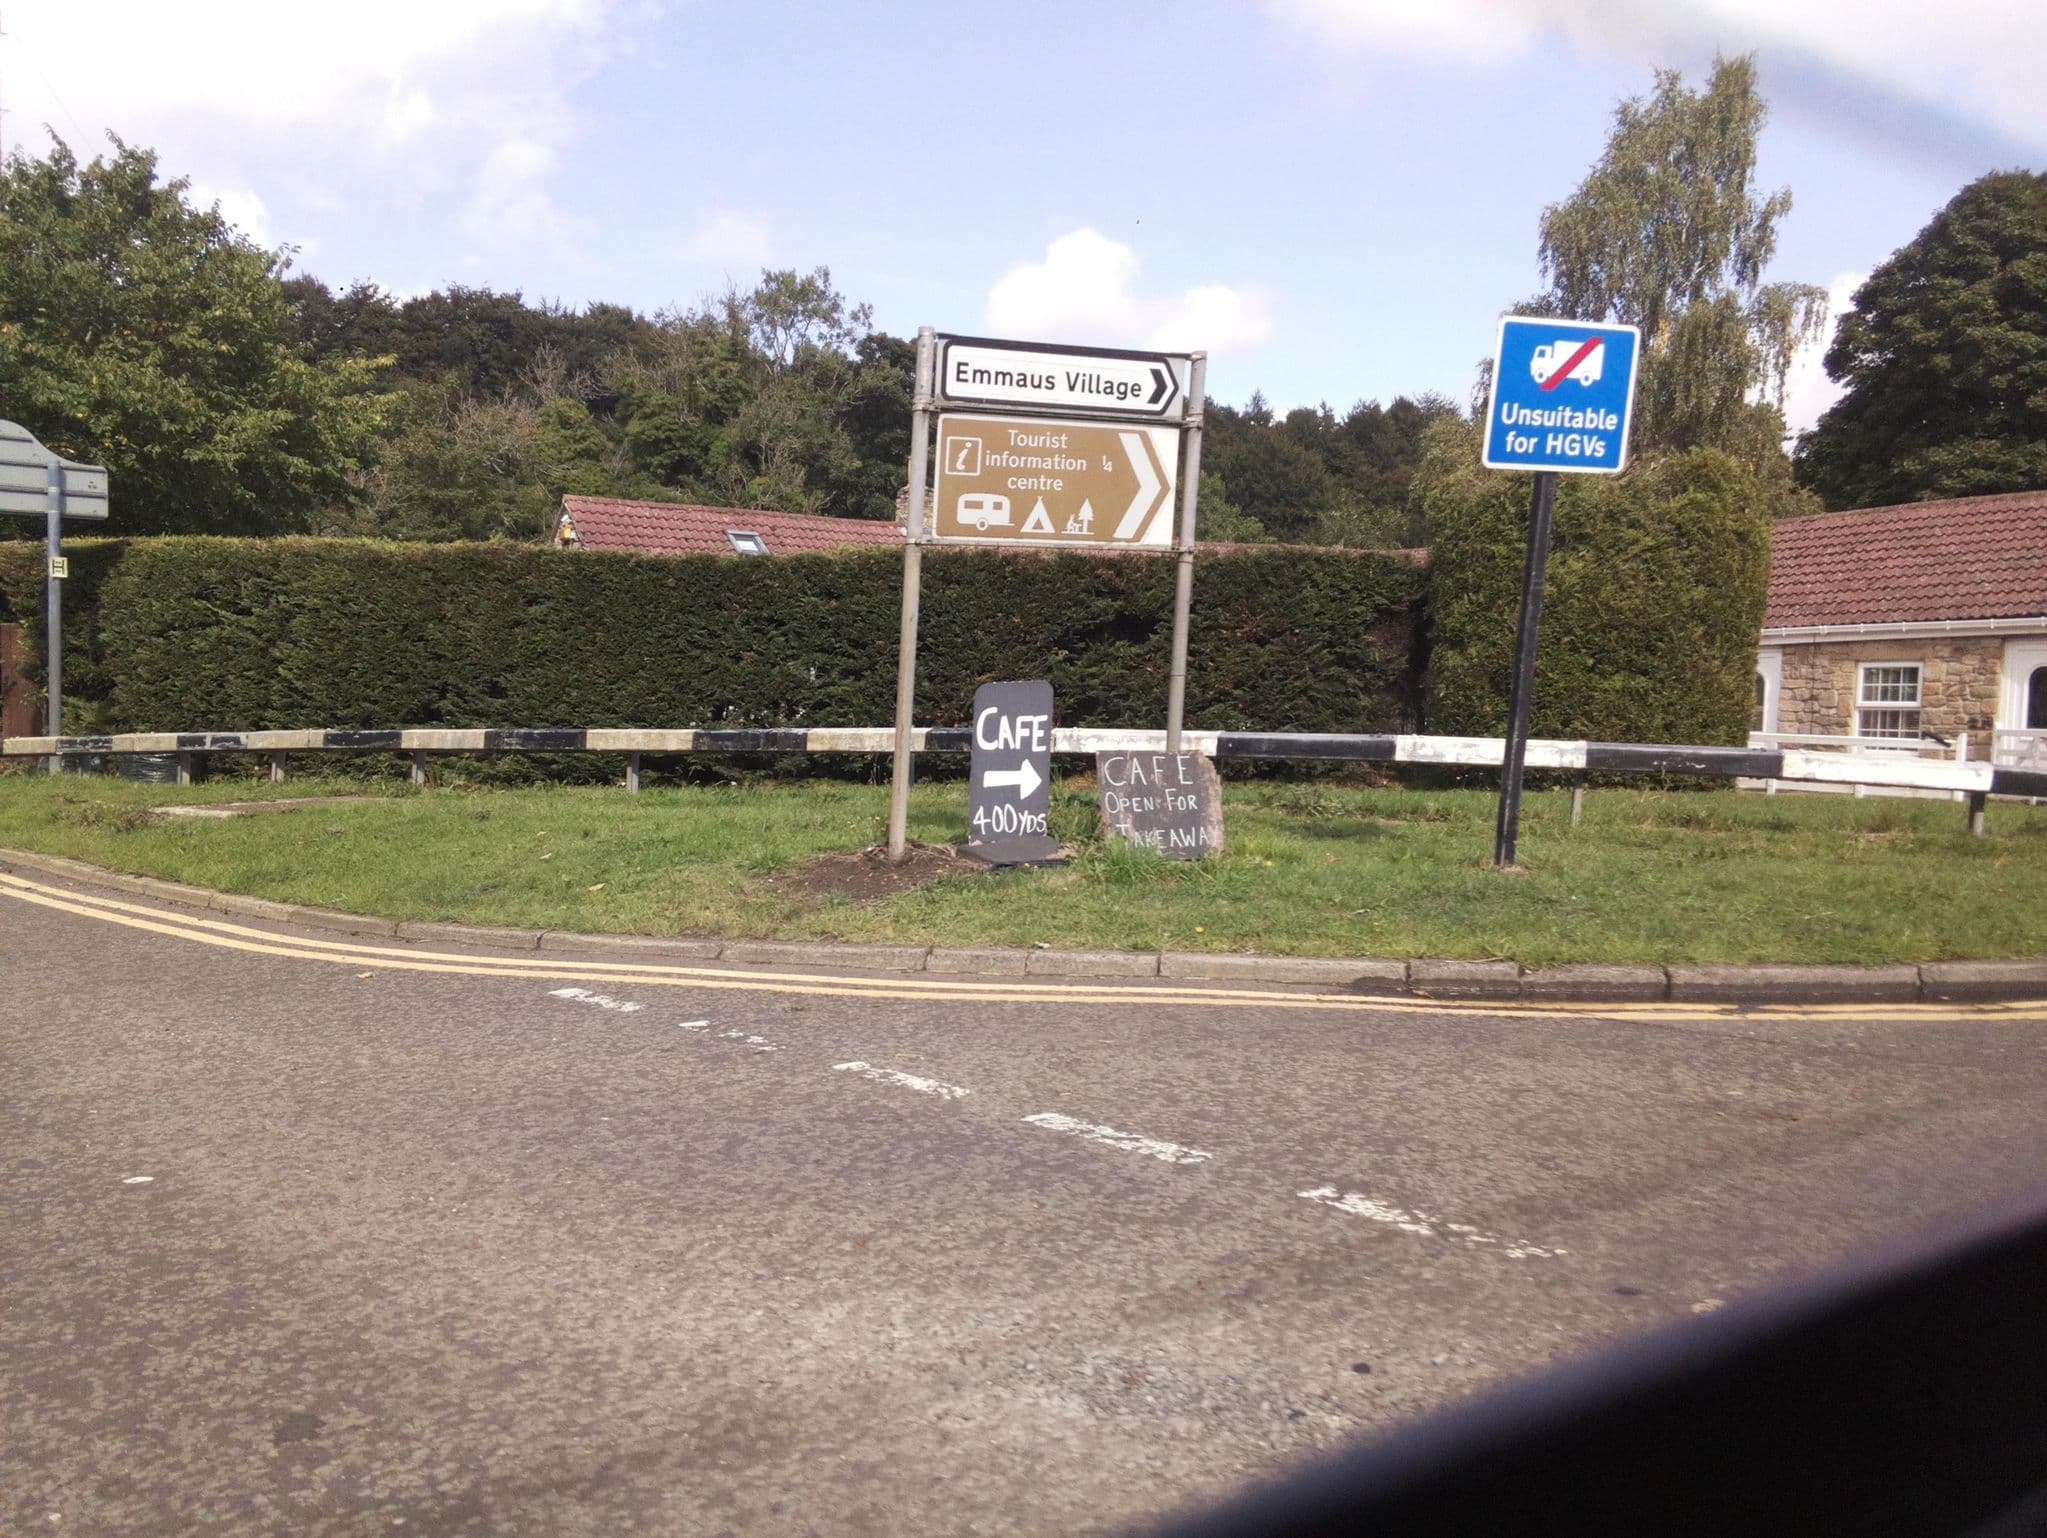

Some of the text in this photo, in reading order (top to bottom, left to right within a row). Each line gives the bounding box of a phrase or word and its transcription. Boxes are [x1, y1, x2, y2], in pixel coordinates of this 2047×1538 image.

[955, 361, 1142, 401] Emmaus Village
[1501, 402, 1618, 431] Unsuitable
[1007, 429, 1068, 449] Tourist
[1505, 430, 1606, 458] for HGVs
[985, 450, 1087, 472] information
[1007, 473, 1064, 491] centre
[976, 707, 1048, 752] CAFE
[1104, 755, 1194, 786] CAFE
[1104, 787, 1198, 814] OPEN FOR
